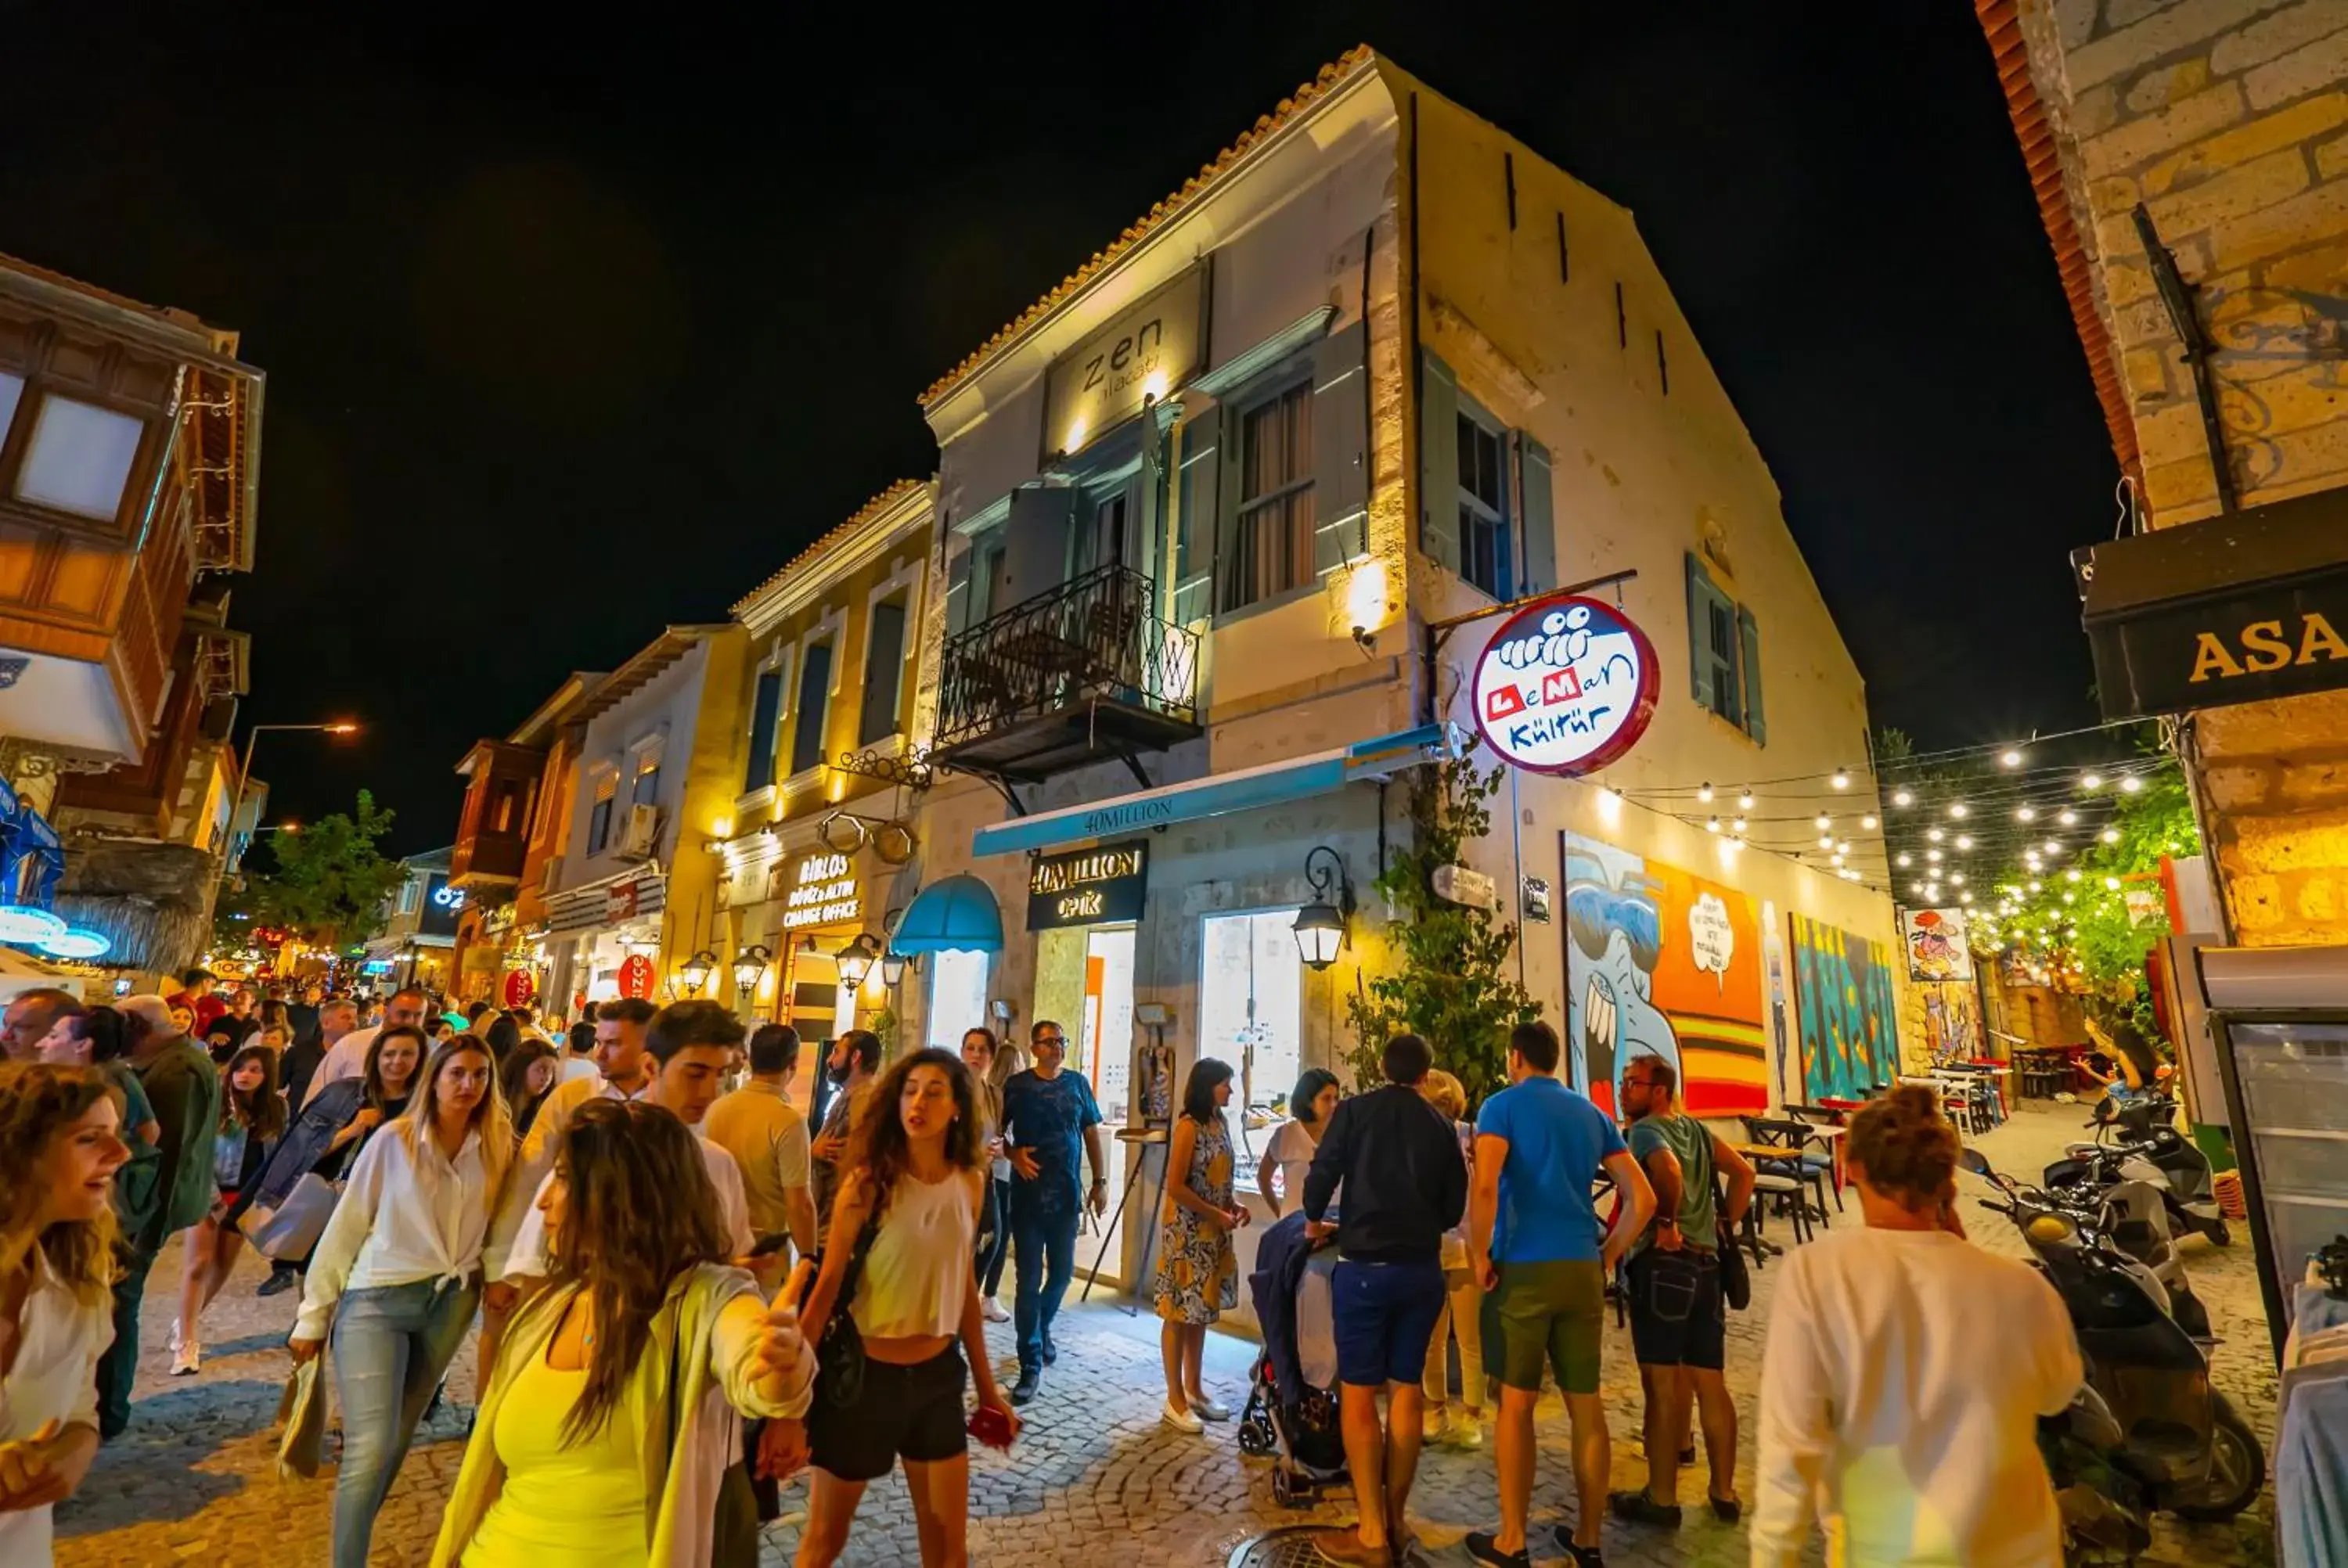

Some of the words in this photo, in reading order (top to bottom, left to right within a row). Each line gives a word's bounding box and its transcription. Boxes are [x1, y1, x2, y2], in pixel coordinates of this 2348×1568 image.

[1084, 318, 1161, 392] zen
[2189, 613, 2348, 682] ASA
[1509, 706, 1611, 750] Kültür
[1083, 800, 1173, 833] 40MILLION
[1028, 850, 1143, 894] 40MILLION
[822, 901, 859, 922] OFFICE
